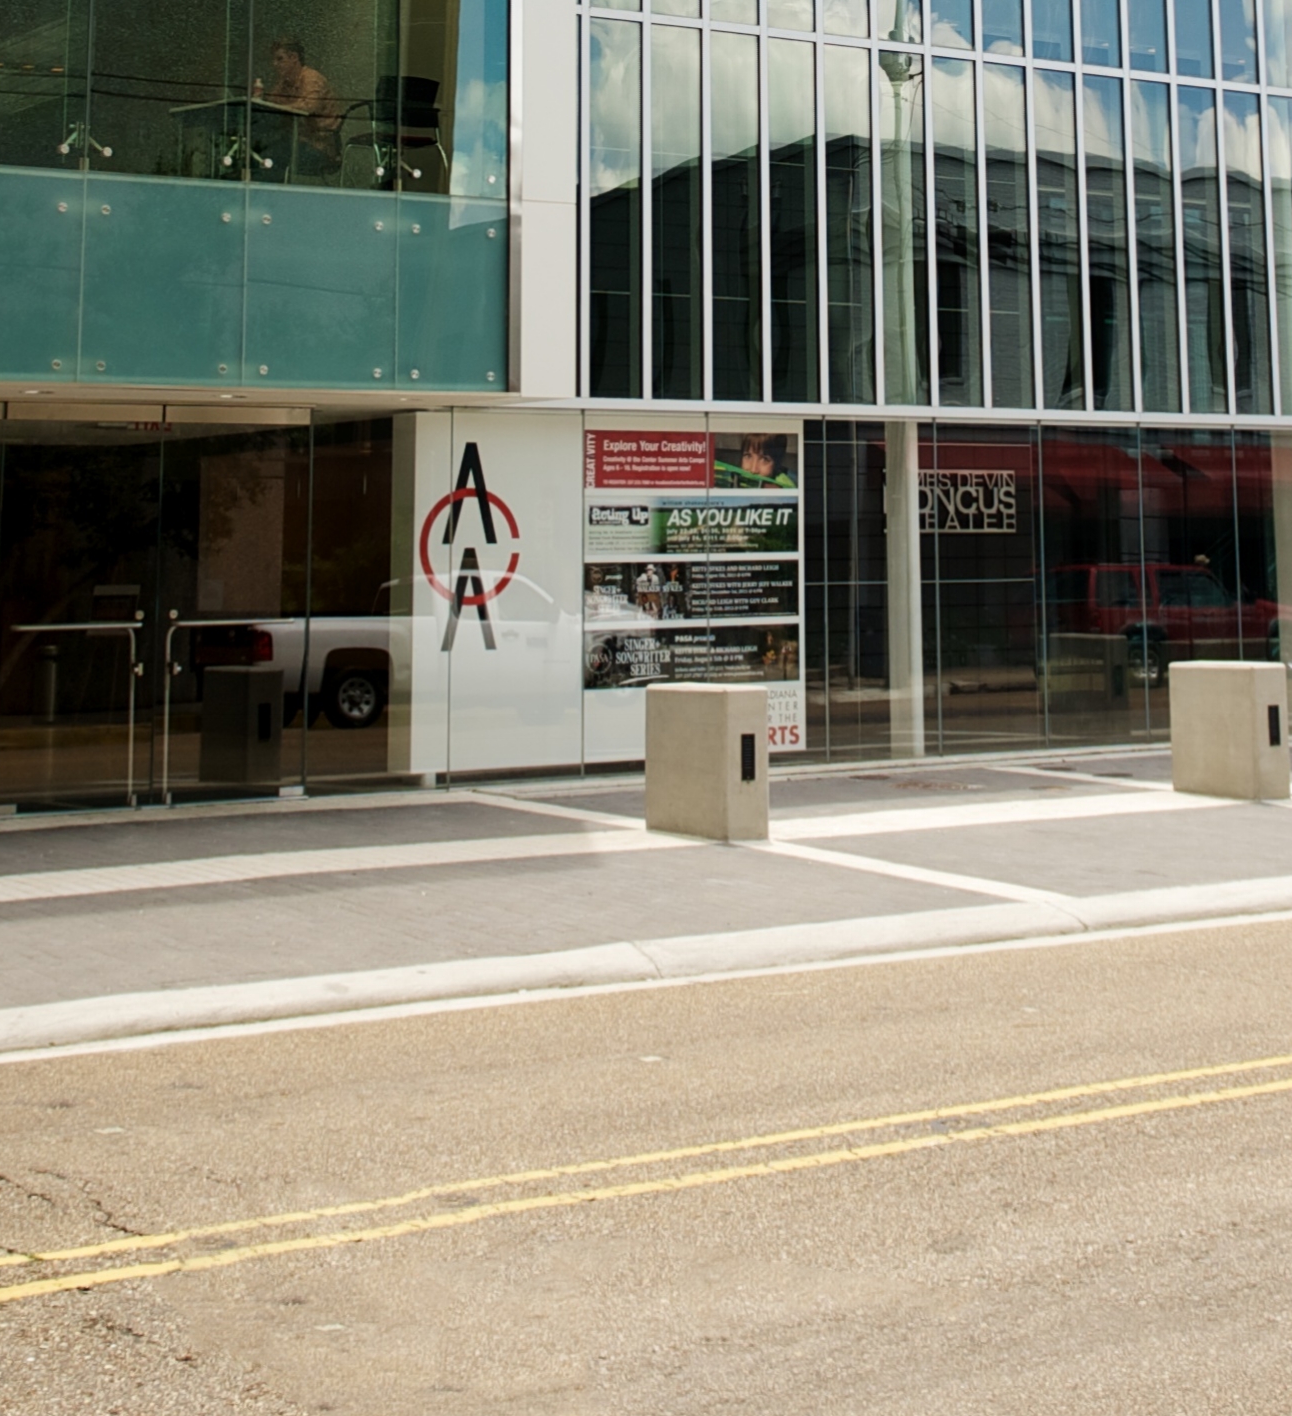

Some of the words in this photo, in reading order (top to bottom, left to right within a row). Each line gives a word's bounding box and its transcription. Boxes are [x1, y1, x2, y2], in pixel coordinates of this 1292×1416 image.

[602, 439, 638, 453] Explore
[639, 440, 660, 452] Your
[661, 440, 707, 454] Creativity!
[919, 486, 1016, 514] ONCUS
[666, 509, 692, 526] AS
[695, 508, 734, 526] YOU
[734, 508, 774, 526] LIKE
[775, 508, 793, 526] IT
[615, 649, 671, 665] SONGWRITER
[630, 662, 661, 676] SERIES
[767, 725, 800, 746] RTS
